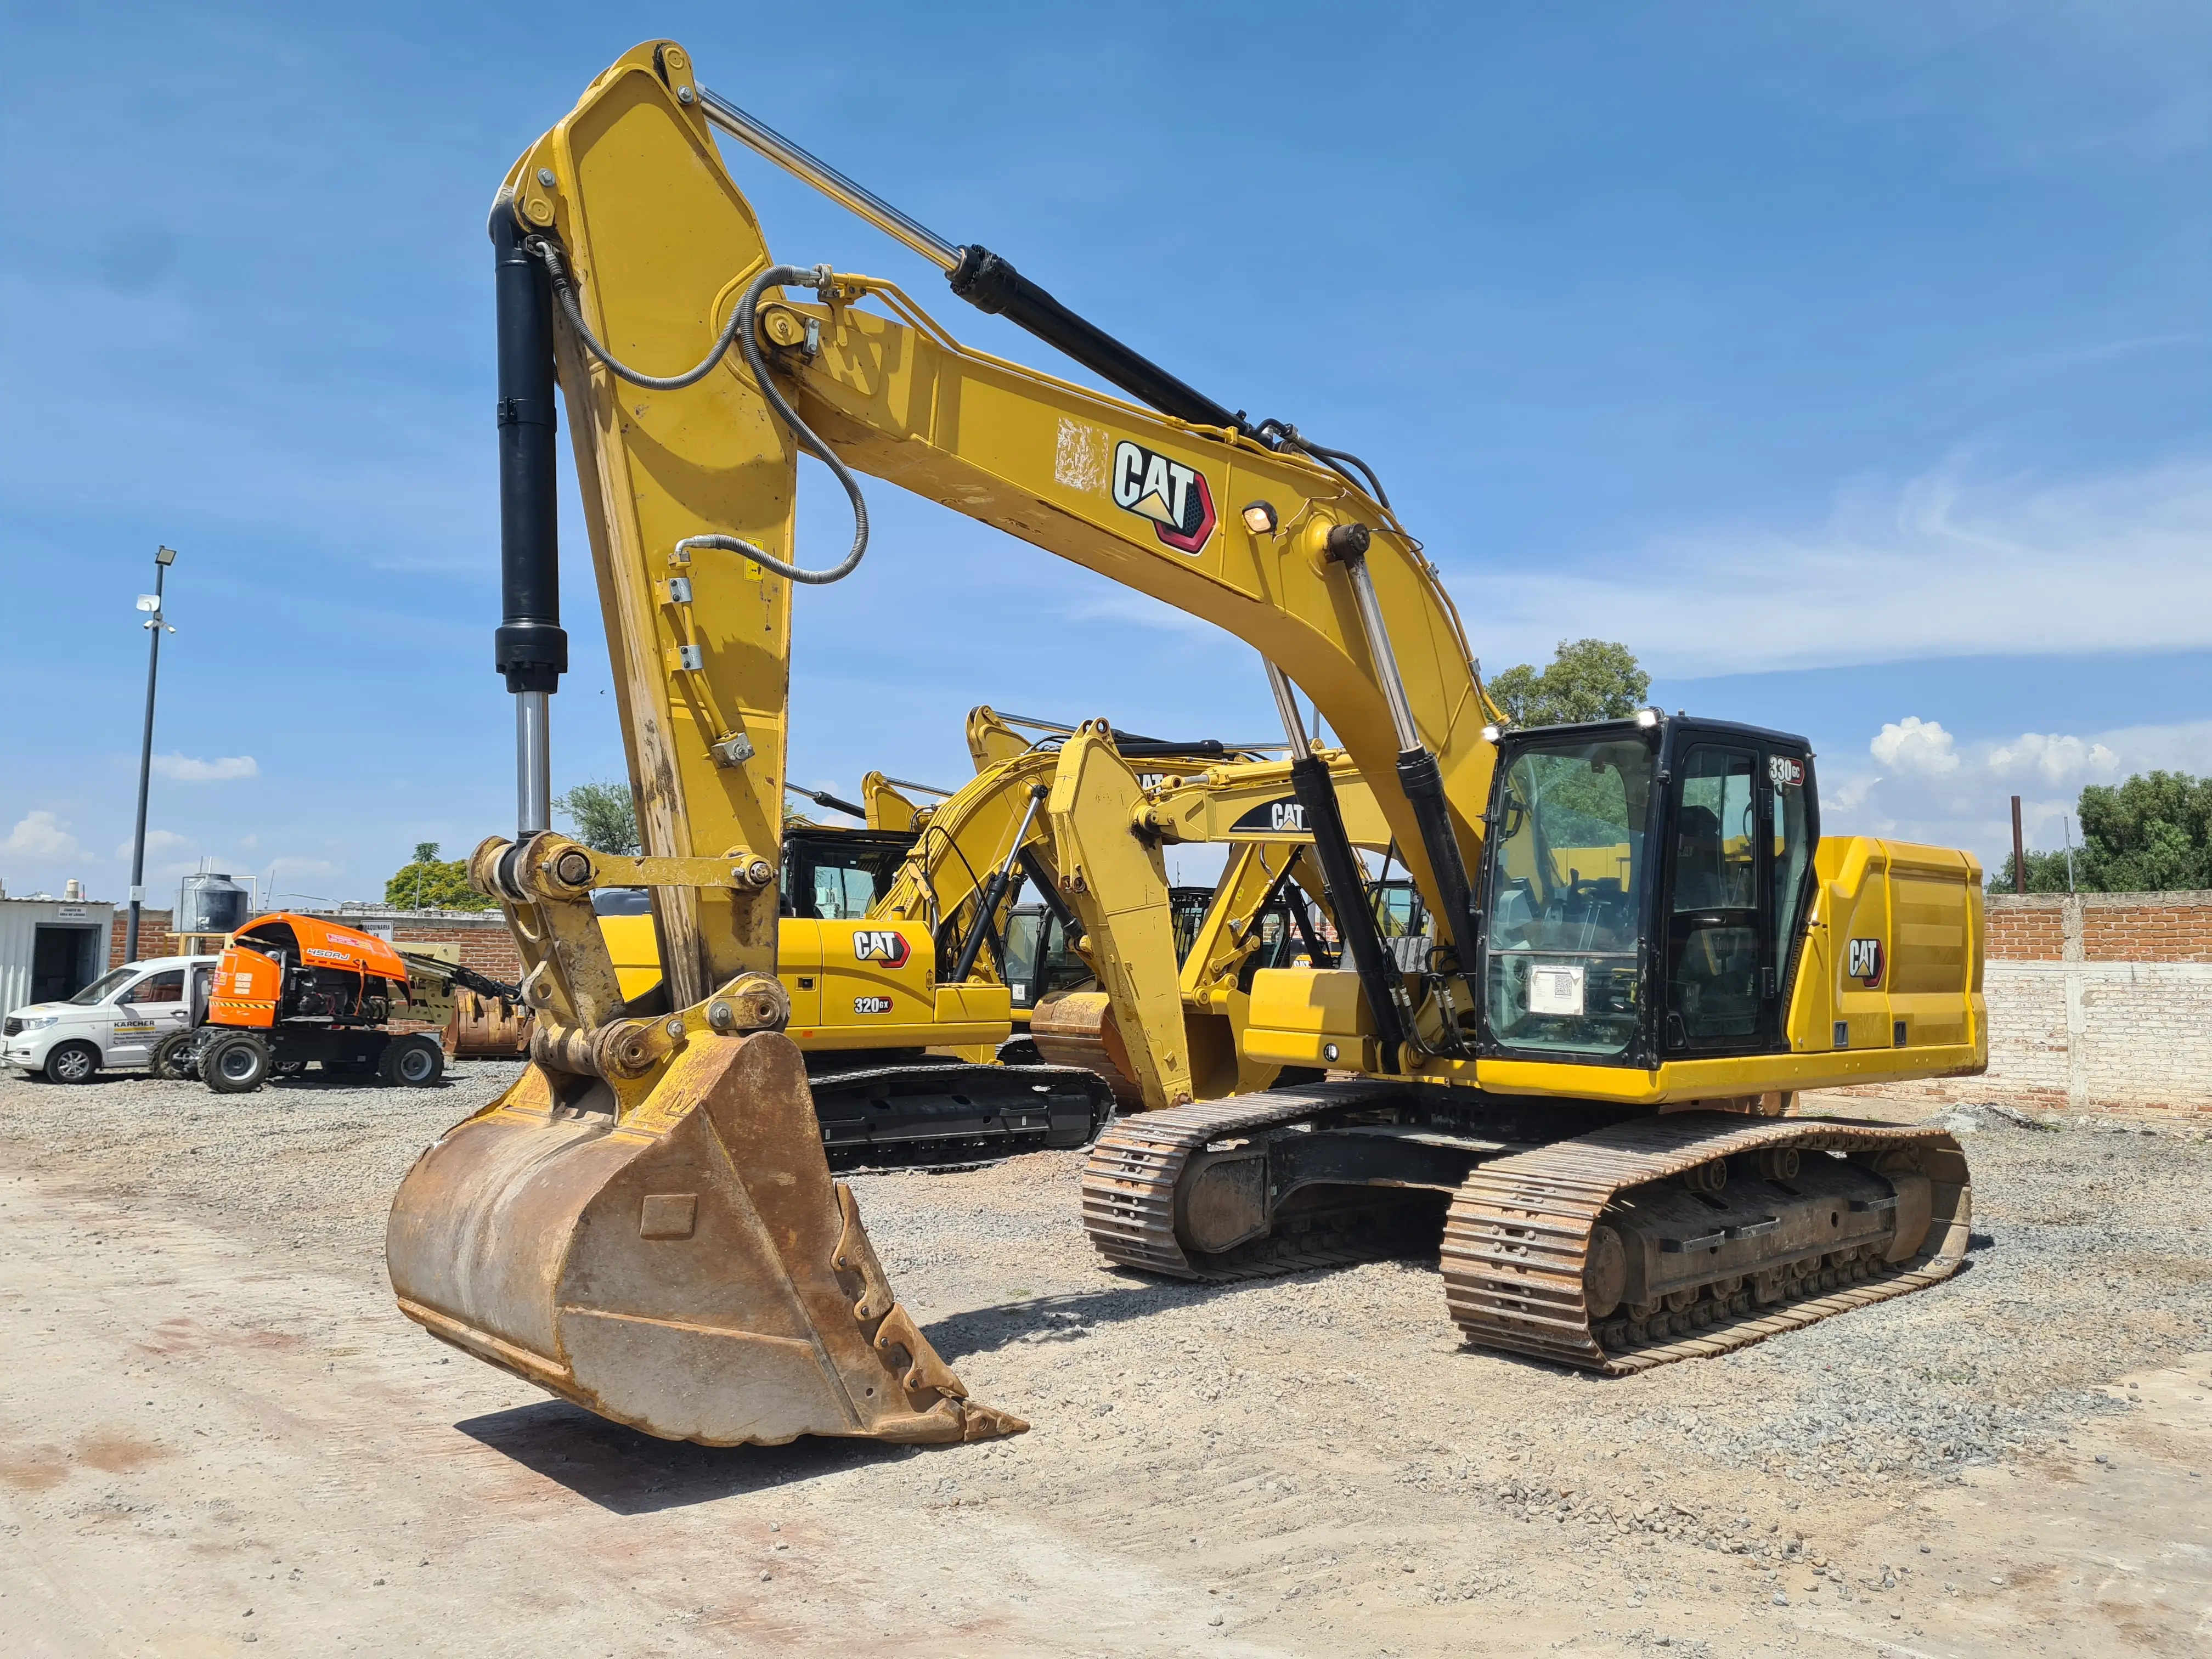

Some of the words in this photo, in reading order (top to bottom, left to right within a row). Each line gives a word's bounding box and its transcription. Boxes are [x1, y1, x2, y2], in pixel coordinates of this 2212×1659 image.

[1114, 442, 1194, 529] CAT
[1135, 774, 1163, 793] AT
[1272, 803, 1305, 831] CAT
[308, 949, 349, 960] 450AJ
[853, 932, 895, 960] CAT
[1849, 939, 1877, 976] CAT
